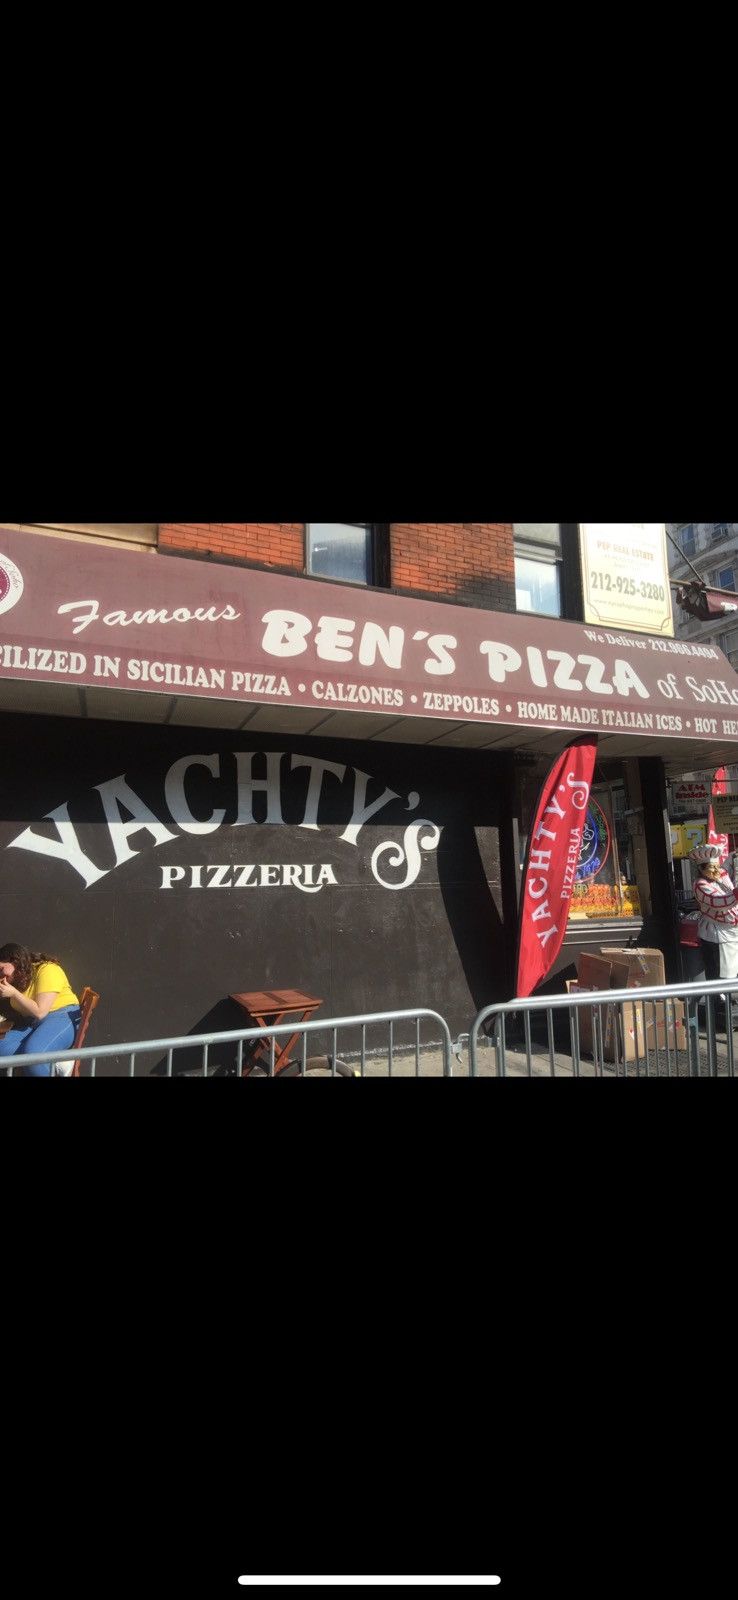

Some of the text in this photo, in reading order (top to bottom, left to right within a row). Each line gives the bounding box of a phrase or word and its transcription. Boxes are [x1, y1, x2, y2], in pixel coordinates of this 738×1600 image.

[591, 571, 665, 602] 212-925-3280
[57, 599, 241, 635] Famous
[583, 629, 605, 643] We
[605, 633, 647, 650] Deliver
[261, 609, 650, 700] BEN'S PIZZA
[0, 644, 738, 736] ILIZED IN SICILIAN PIZZA CALZONES ZEPPOLES HOME MADE ITALIAN ICES HOT HE
[657, 673, 683, 700] of
[7, 751, 445, 890] YACHTY'S
[159, 863, 339, 893] PIZZERIA
[528, 771, 591, 948] YACHTY'S
[560, 826, 581, 899] PIZZERIA
